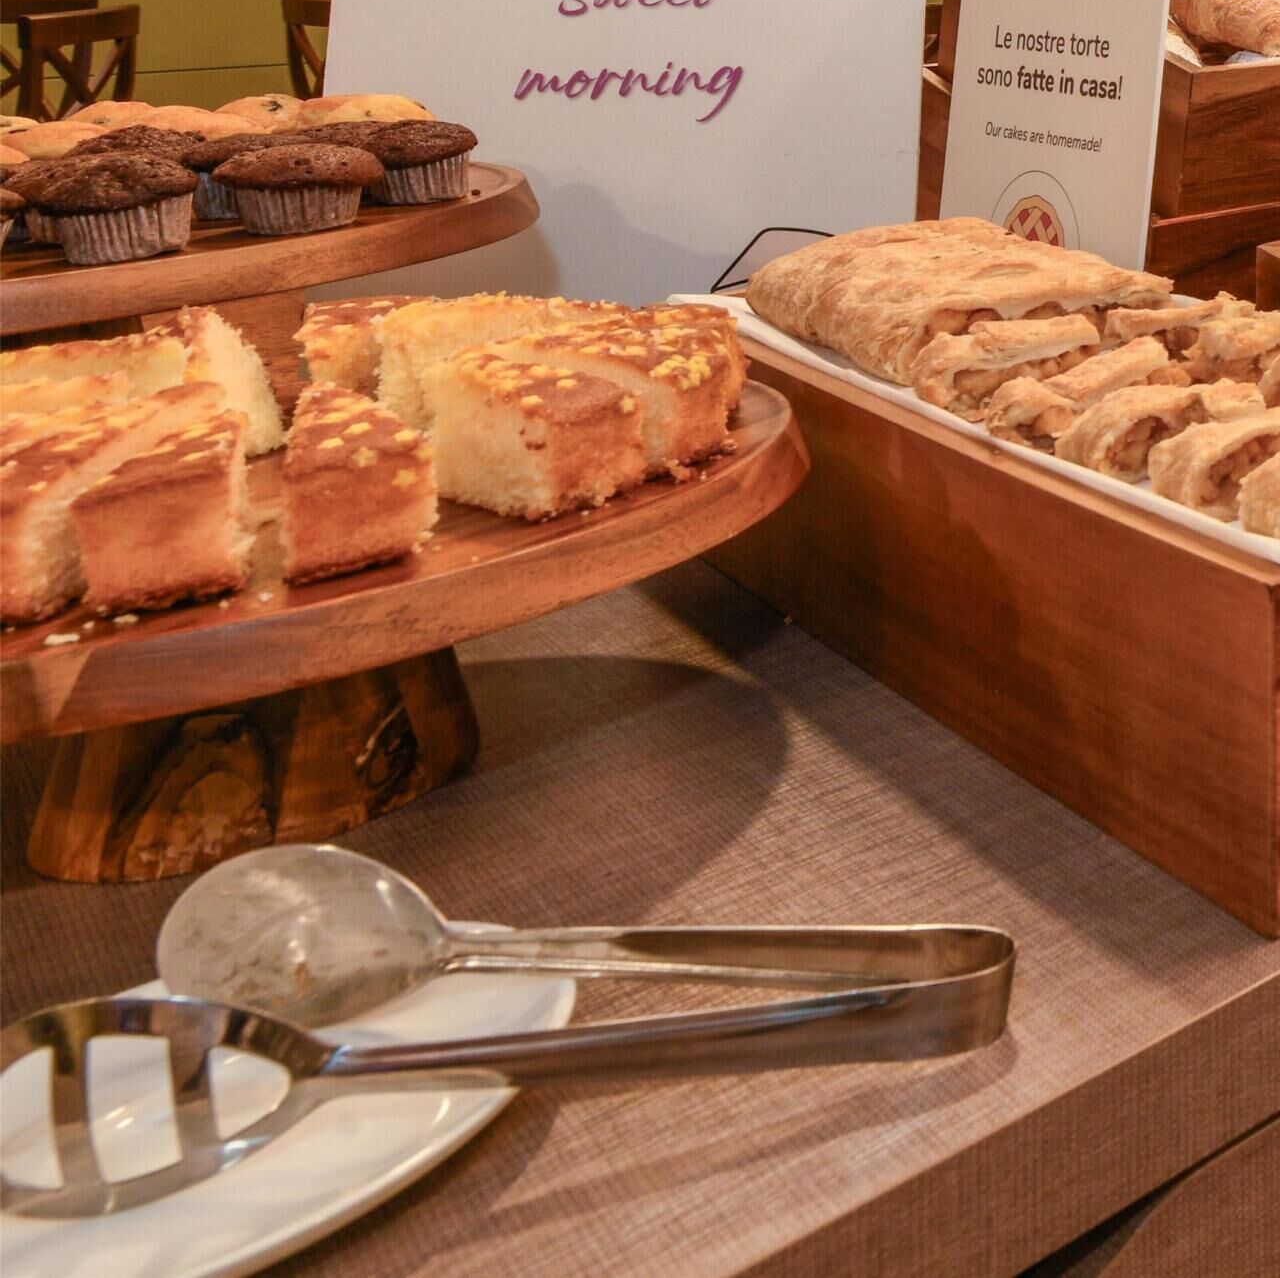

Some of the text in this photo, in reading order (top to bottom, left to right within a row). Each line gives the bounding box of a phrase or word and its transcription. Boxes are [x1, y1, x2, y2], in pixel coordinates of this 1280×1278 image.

[995, 24, 1110, 58] Le nostre torte
[513, 61, 744, 123] morning
[977, 65, 1123, 100] sono fatte in casa!
[985, 122, 1102, 153] Our cakes are homemade!
